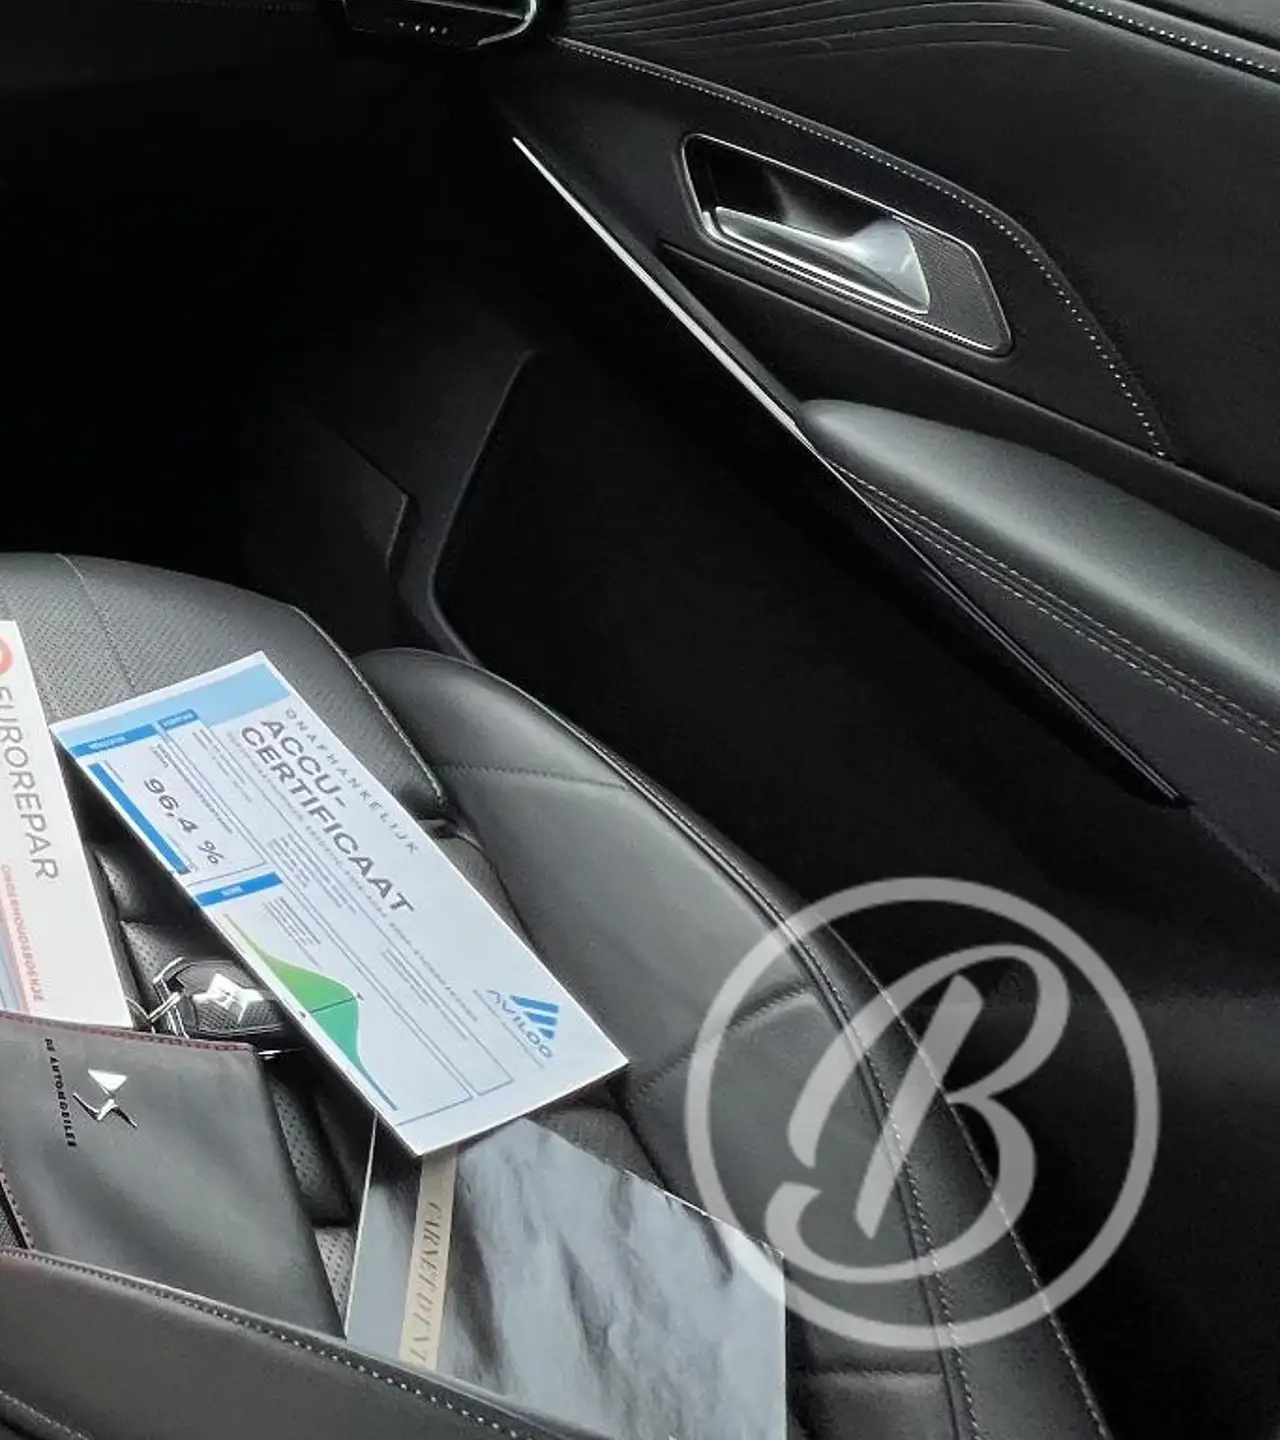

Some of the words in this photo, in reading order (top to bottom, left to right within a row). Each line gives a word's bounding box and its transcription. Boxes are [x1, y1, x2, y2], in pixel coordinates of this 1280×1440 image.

[143, 777, 200, 835] 96,4
[239, 725, 416, 916] CERTIFICAAT
[259, 718, 349, 810] ACCU-
[284, 708, 420, 856] ONAFHANKELIJK
